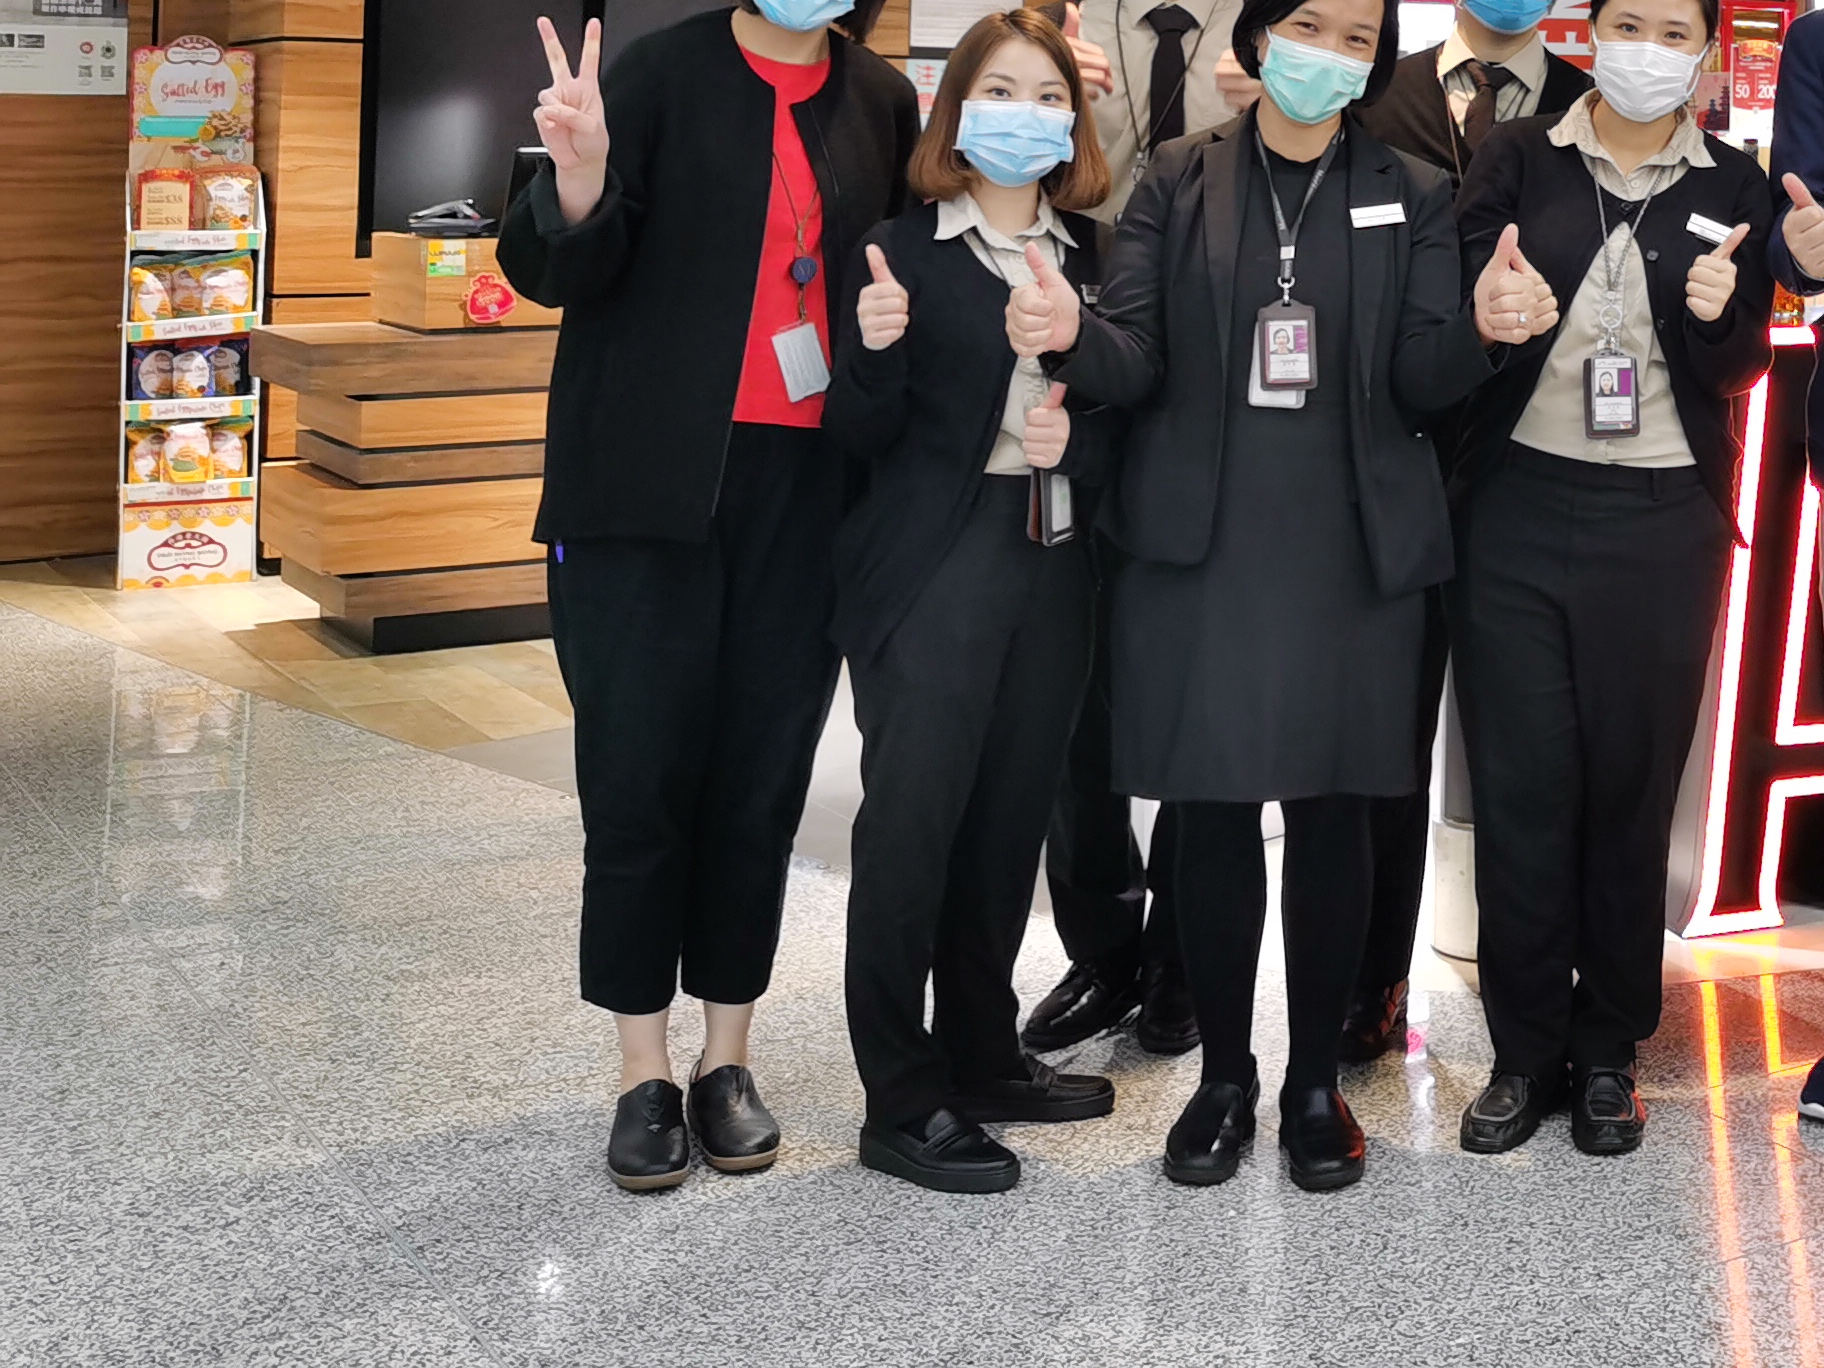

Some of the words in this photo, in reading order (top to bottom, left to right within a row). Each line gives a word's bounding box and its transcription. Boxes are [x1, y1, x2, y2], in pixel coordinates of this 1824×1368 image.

[161, 81, 200, 103] Salted
[204, 77, 226, 99] Egg
[1735, 83, 1751, 99] 50
